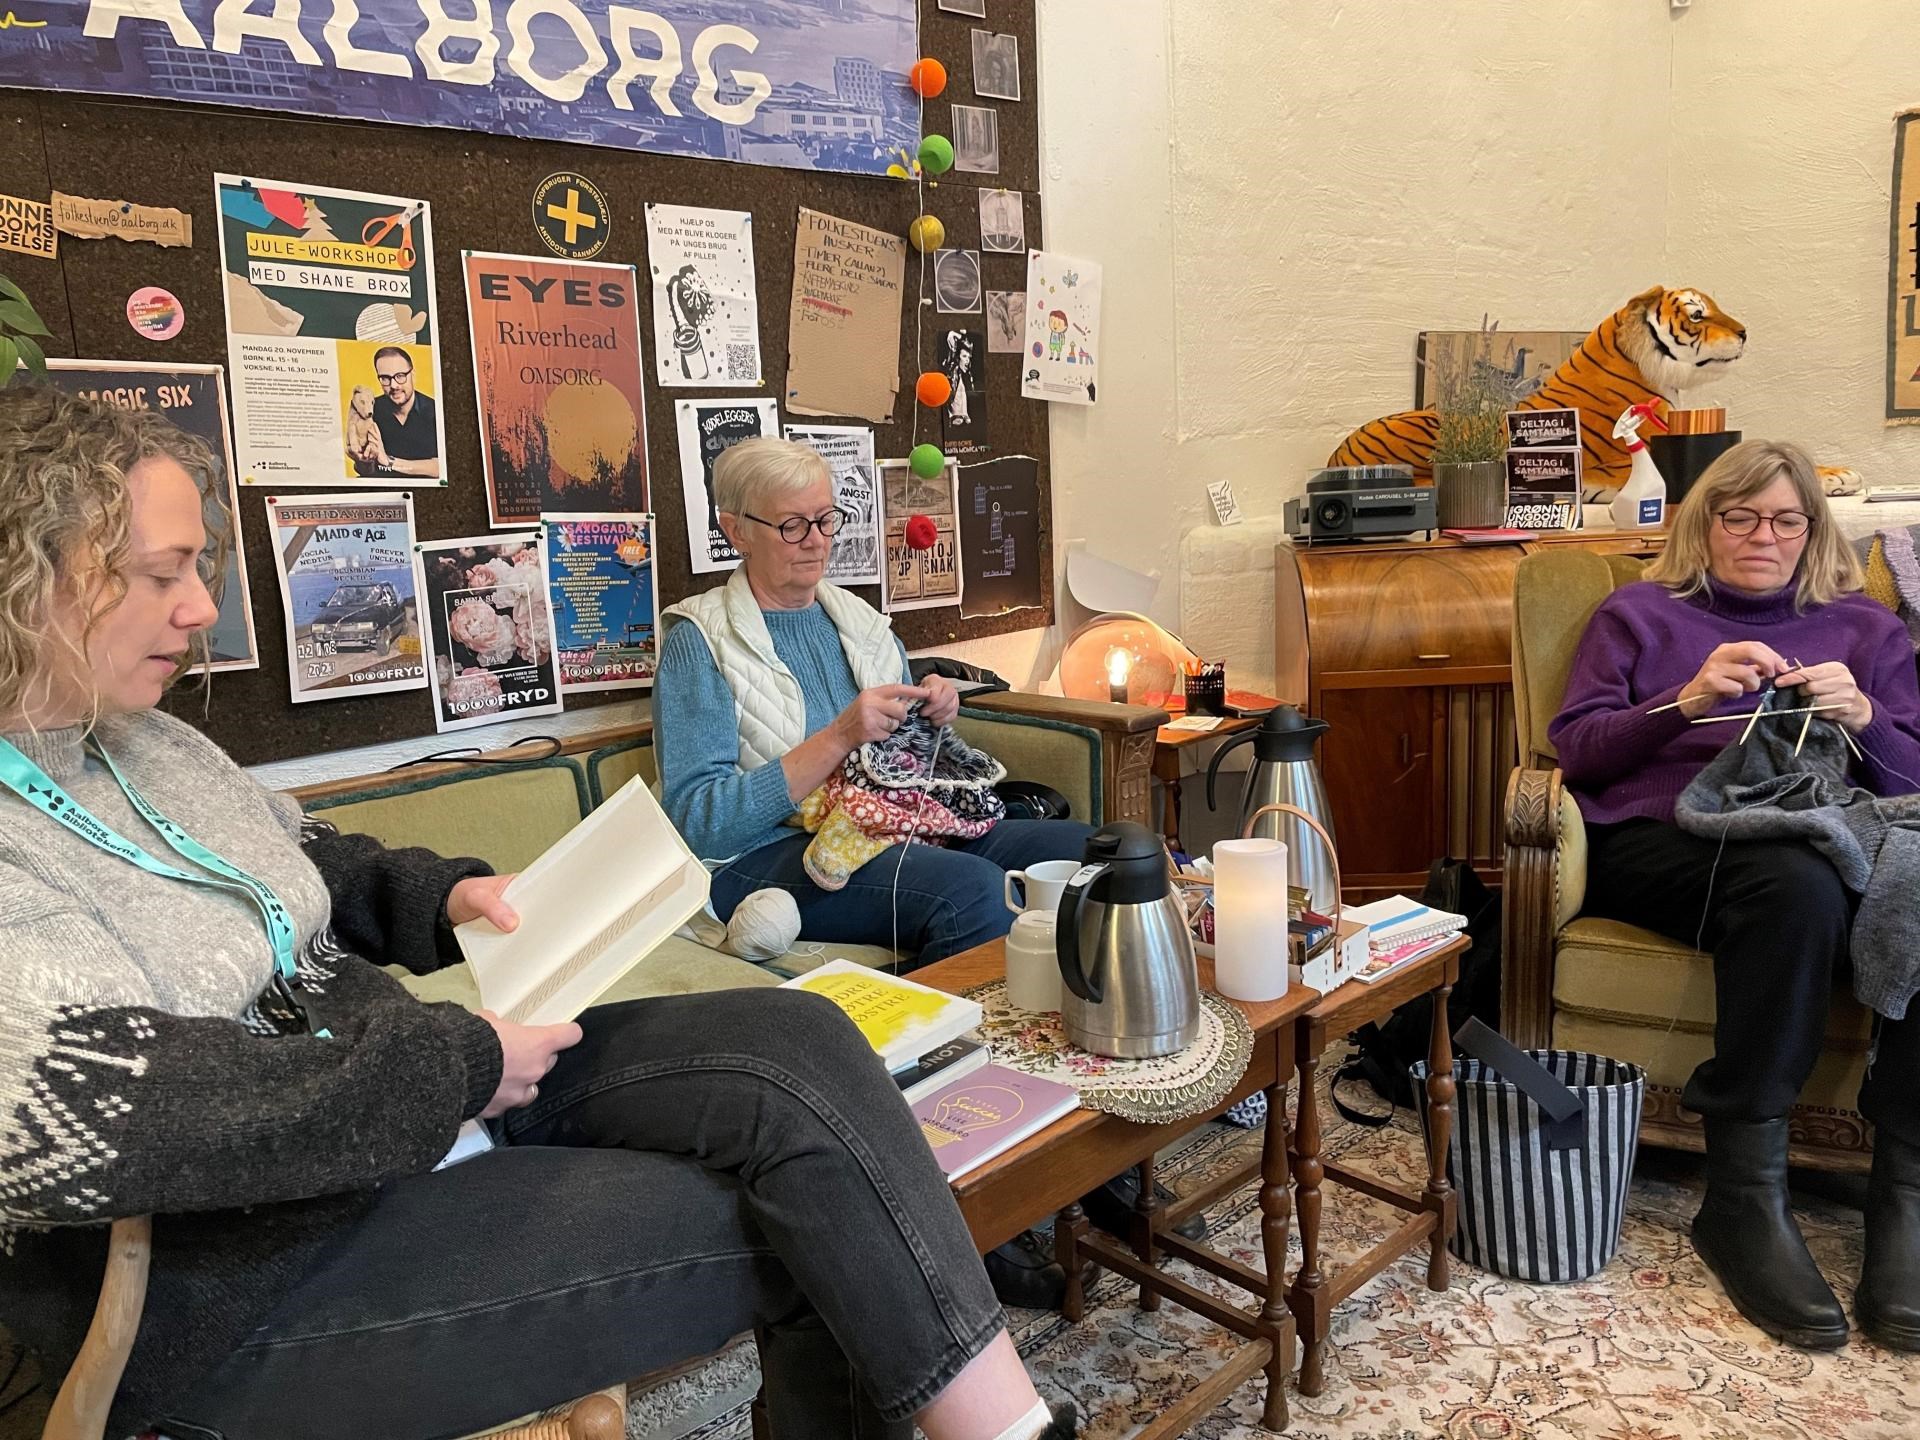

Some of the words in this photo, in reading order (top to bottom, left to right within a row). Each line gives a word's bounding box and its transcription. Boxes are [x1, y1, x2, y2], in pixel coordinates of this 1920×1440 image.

[536, 175, 572, 206] STOFBRUGER
[680, 218, 704, 226] HJÆLP
[705, 220, 715, 228] OS
[657, 227, 673, 235] MED
[674, 228, 683, 236] AT
[684, 230, 704, 238] BLIVE
[705, 232, 737, 240] KLOGERE
[539, 225, 568, 256] ANTIDOTE
[572, 240, 603, 258] DANMARK
[683, 241, 707, 249] UNGES
[708, 242, 728, 250] BRUG
[250, 239, 397, 265] JULE-WORKSHOP
[693, 252, 718, 260] PILLER
[251, 267, 286, 282] MED
[300, 272, 355, 289] SHANE
[368, 278, 410, 294] BROX
[479, 273, 626, 308] EYES
[499, 321, 618, 349] Riverhead
[242, 345, 273, 353] MANDAG
[286, 348, 325, 356] NOVEMBER
[520, 366, 603, 386] OMSORG
[157, 384, 193, 408] SIX
[1520, 419, 1558, 428] DELTAG
[1516, 428, 1570, 437] SAMTALEN
[1519, 459, 1557, 467] DELTAG
[1514, 467, 1569, 475] SAMTALEN
[840, 487, 870, 500] ANGST
[281, 509, 360, 520] BIRTHDAY
[364, 509, 403, 519] BASH
[1514, 505, 1570, 514] GRØNNE
[1508, 513, 1568, 521] UNGDOMS
[1506, 520, 1567, 528] BEVÆGELSE
[314, 528, 350, 542] MAID
[300, 547, 330, 559] SOCIAL
[370, 548, 404, 557] FOREVER
[623, 545, 641, 555] FREE
[300, 555, 334, 567] NEDTUR
[369, 555, 405, 564] UNCLEAN
[924, 557, 954, 575] SNAK
[348, 667, 424, 683] 1000FRYD
[564, 662, 646, 678] 1000FRYD
[448, 688, 549, 715] 1000FRYD
[66, 806, 110, 839] Aalborg
[61, 812, 138, 859] Bibliotekerne
[920, 1044, 963, 1069] LONE
